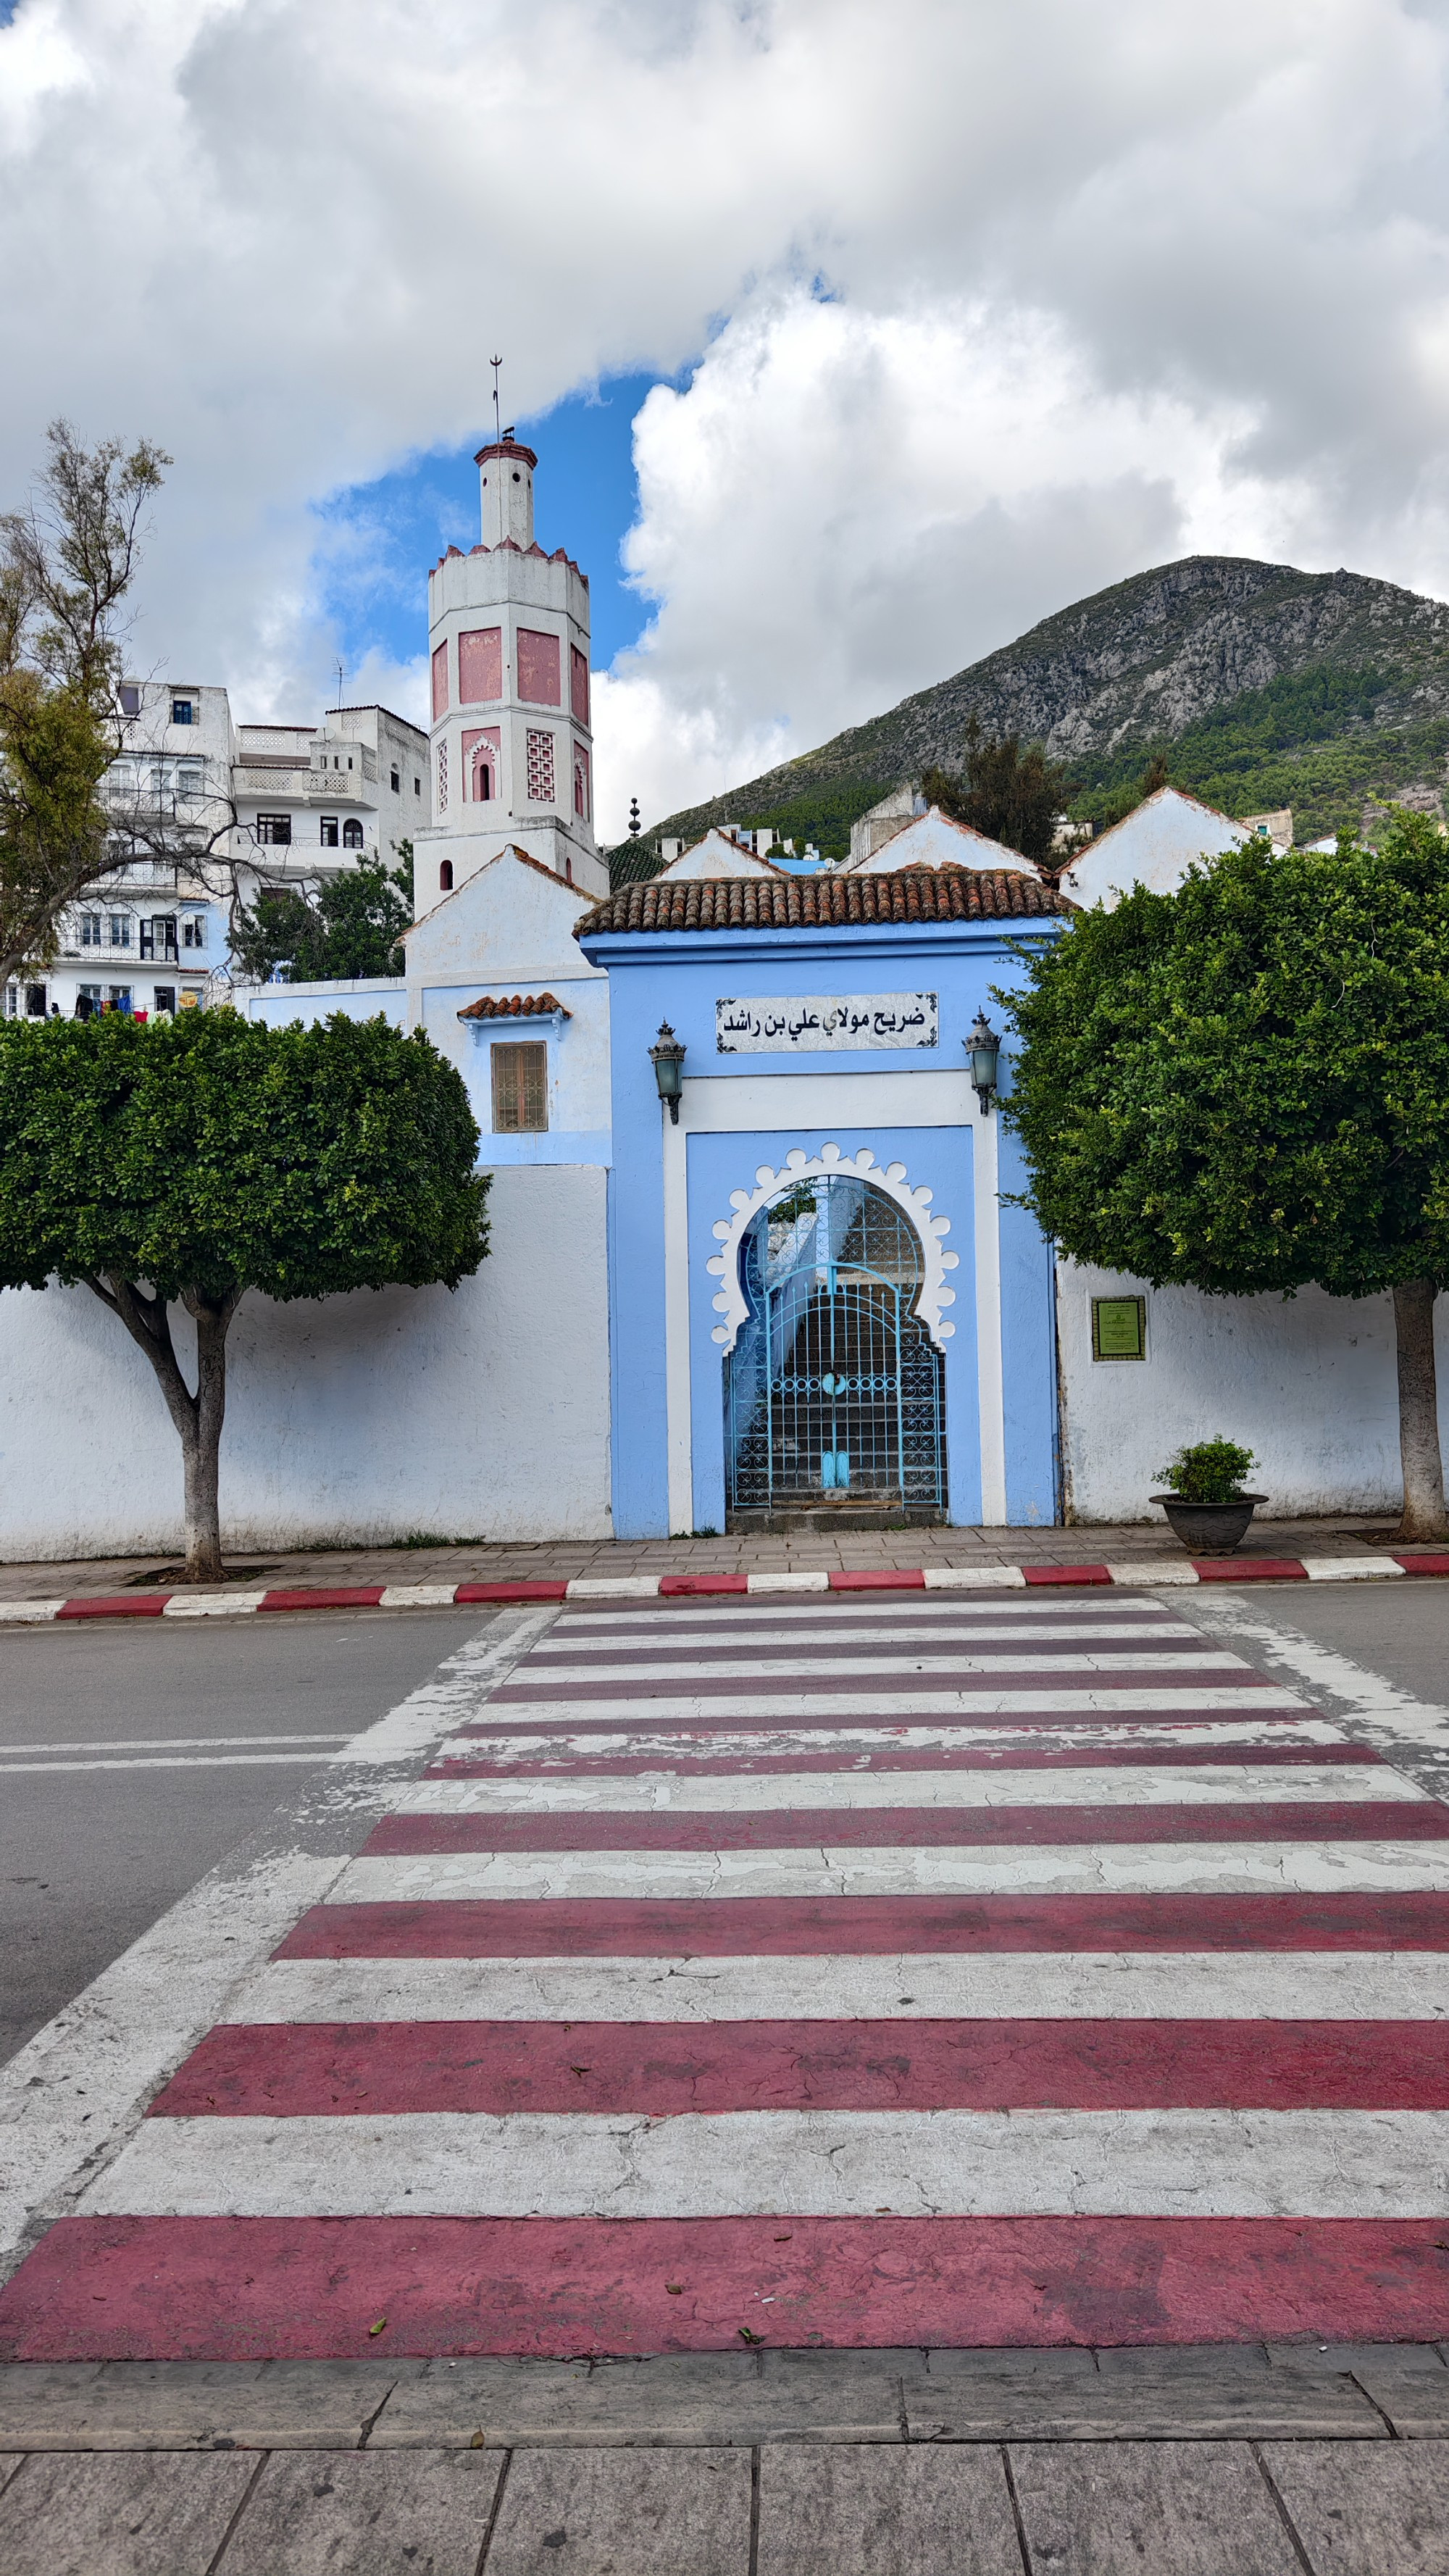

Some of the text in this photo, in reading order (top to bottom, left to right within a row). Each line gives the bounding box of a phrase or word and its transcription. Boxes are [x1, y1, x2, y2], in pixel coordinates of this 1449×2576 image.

[724, 1006, 925, 1041] ضريح مولاي علي بن راشد
